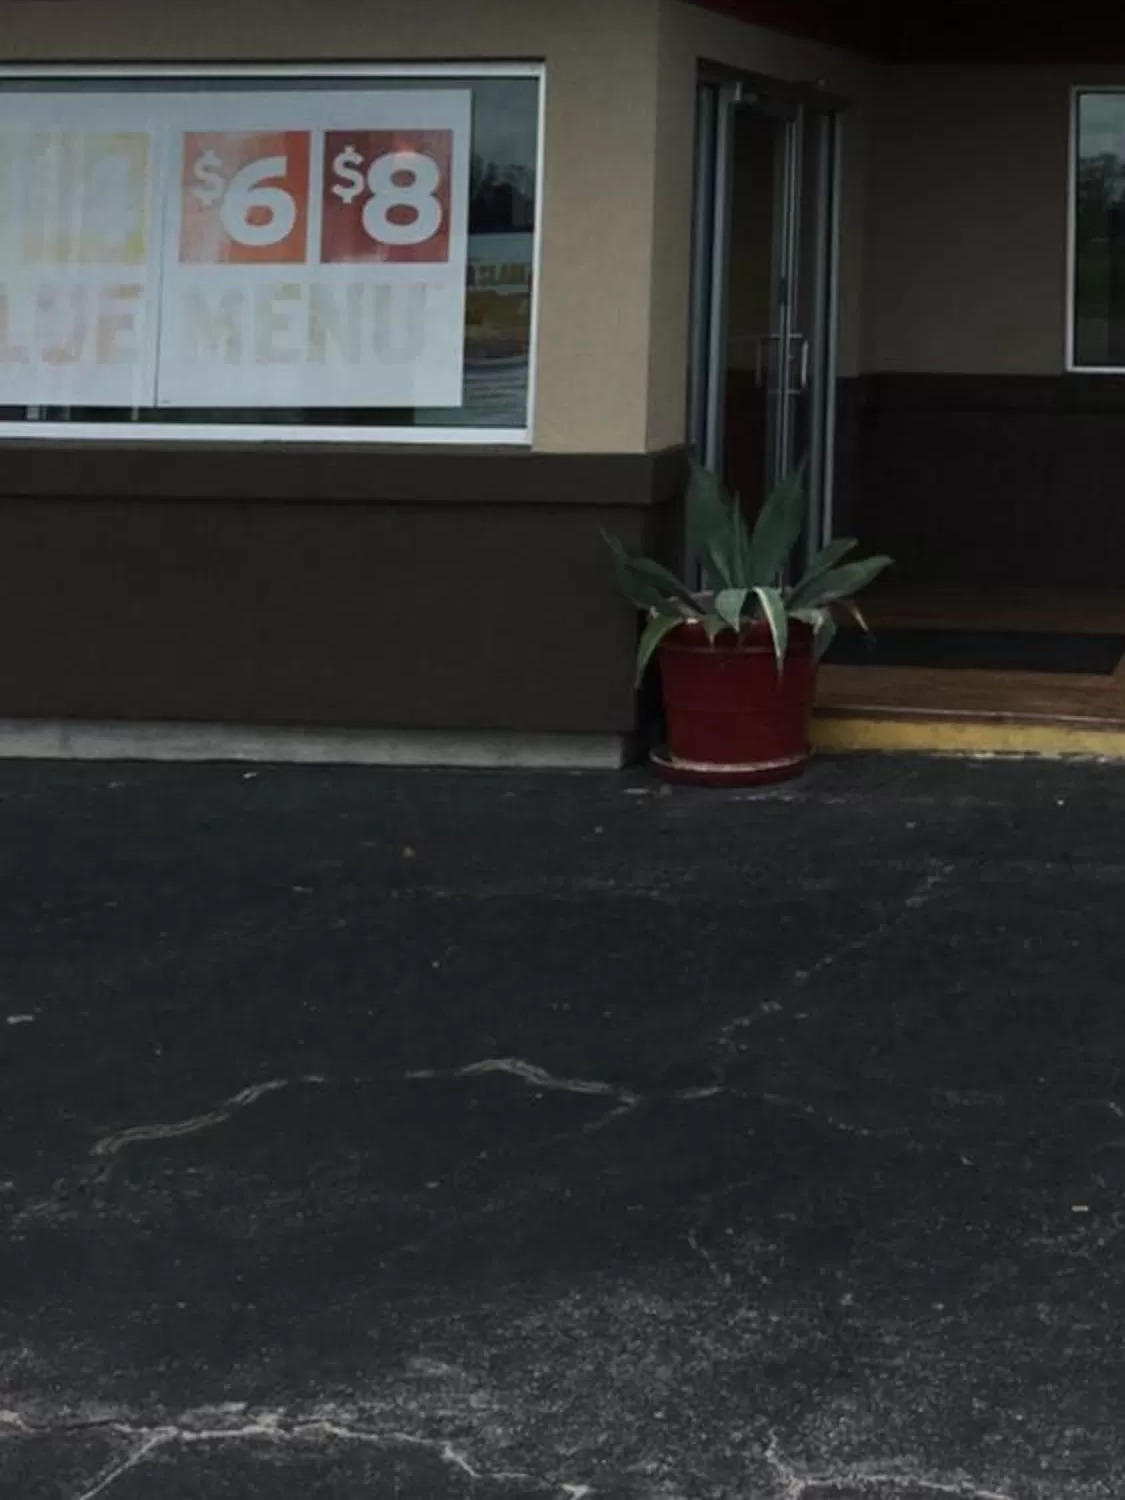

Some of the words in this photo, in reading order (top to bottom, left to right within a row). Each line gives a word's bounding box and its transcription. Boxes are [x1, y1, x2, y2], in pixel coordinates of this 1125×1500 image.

[191, 149, 298, 246] $6
[331, 145, 443, 246] $8
[184, 283, 427, 366] MENU
